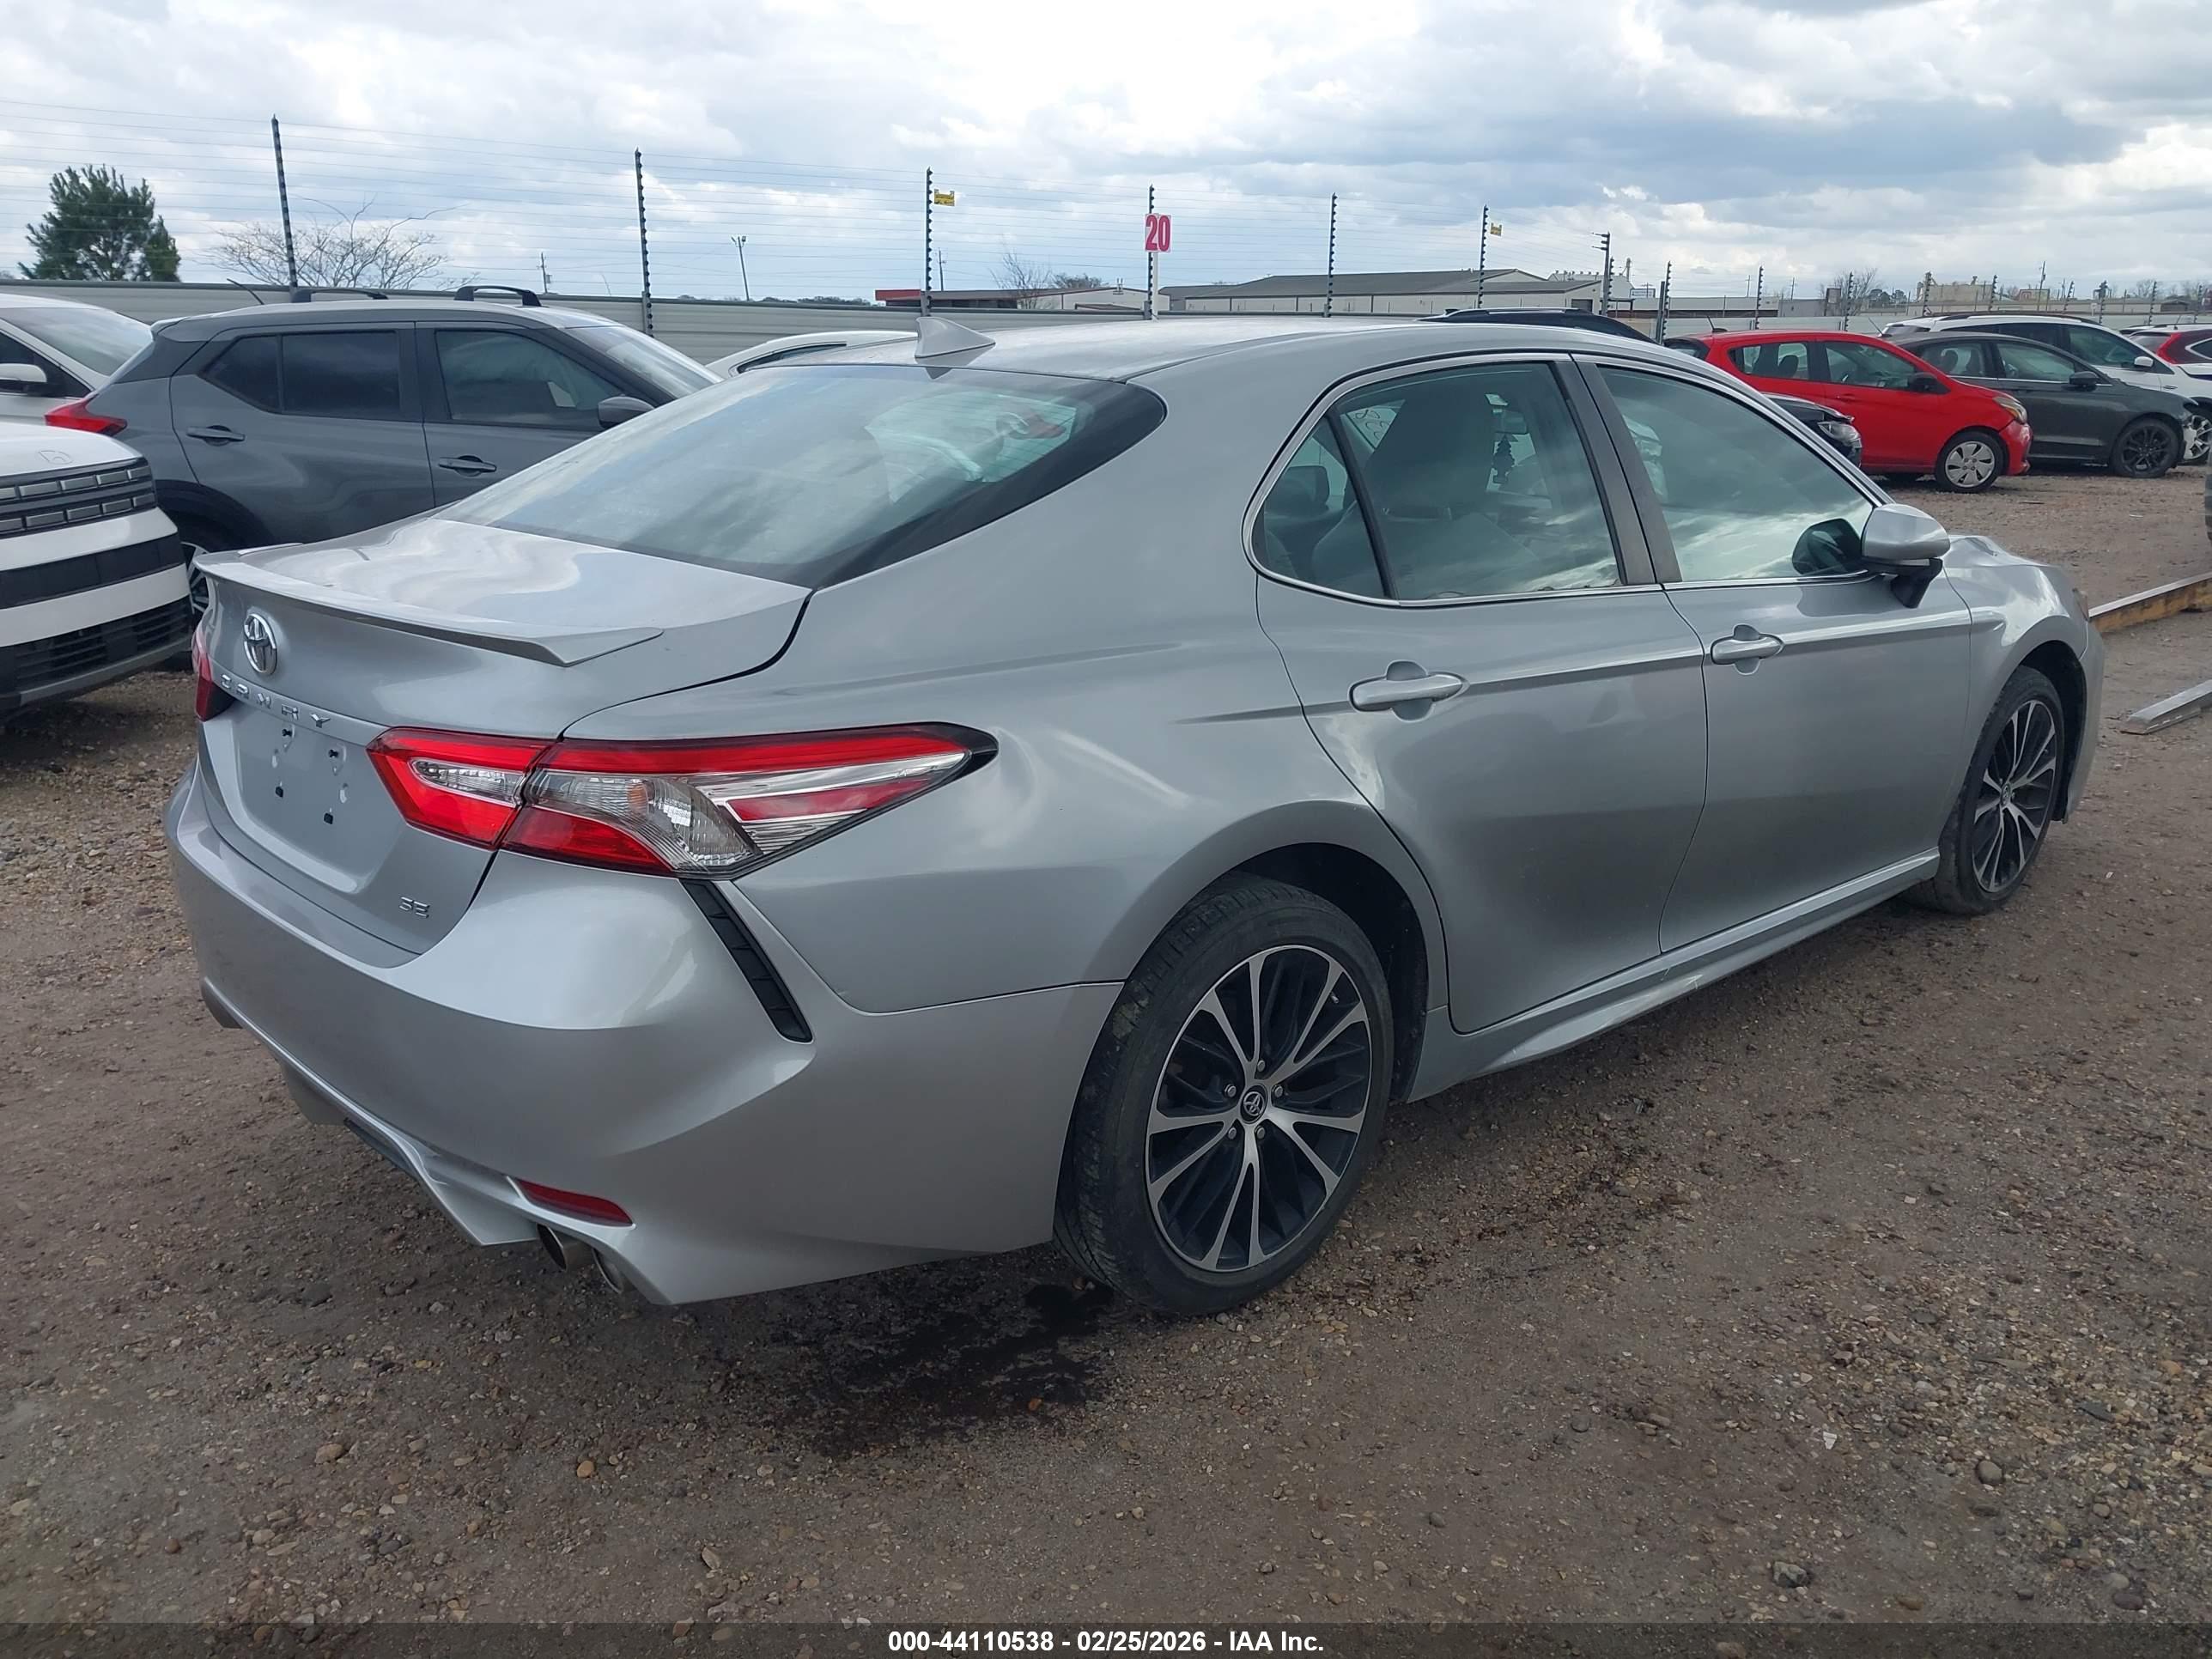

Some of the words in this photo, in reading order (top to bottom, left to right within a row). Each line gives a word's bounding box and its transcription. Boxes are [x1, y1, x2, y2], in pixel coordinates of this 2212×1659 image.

[1146, 215, 1170, 252] 20
[220, 674, 331, 728] CAMRY
[398, 896, 429, 918] SE
